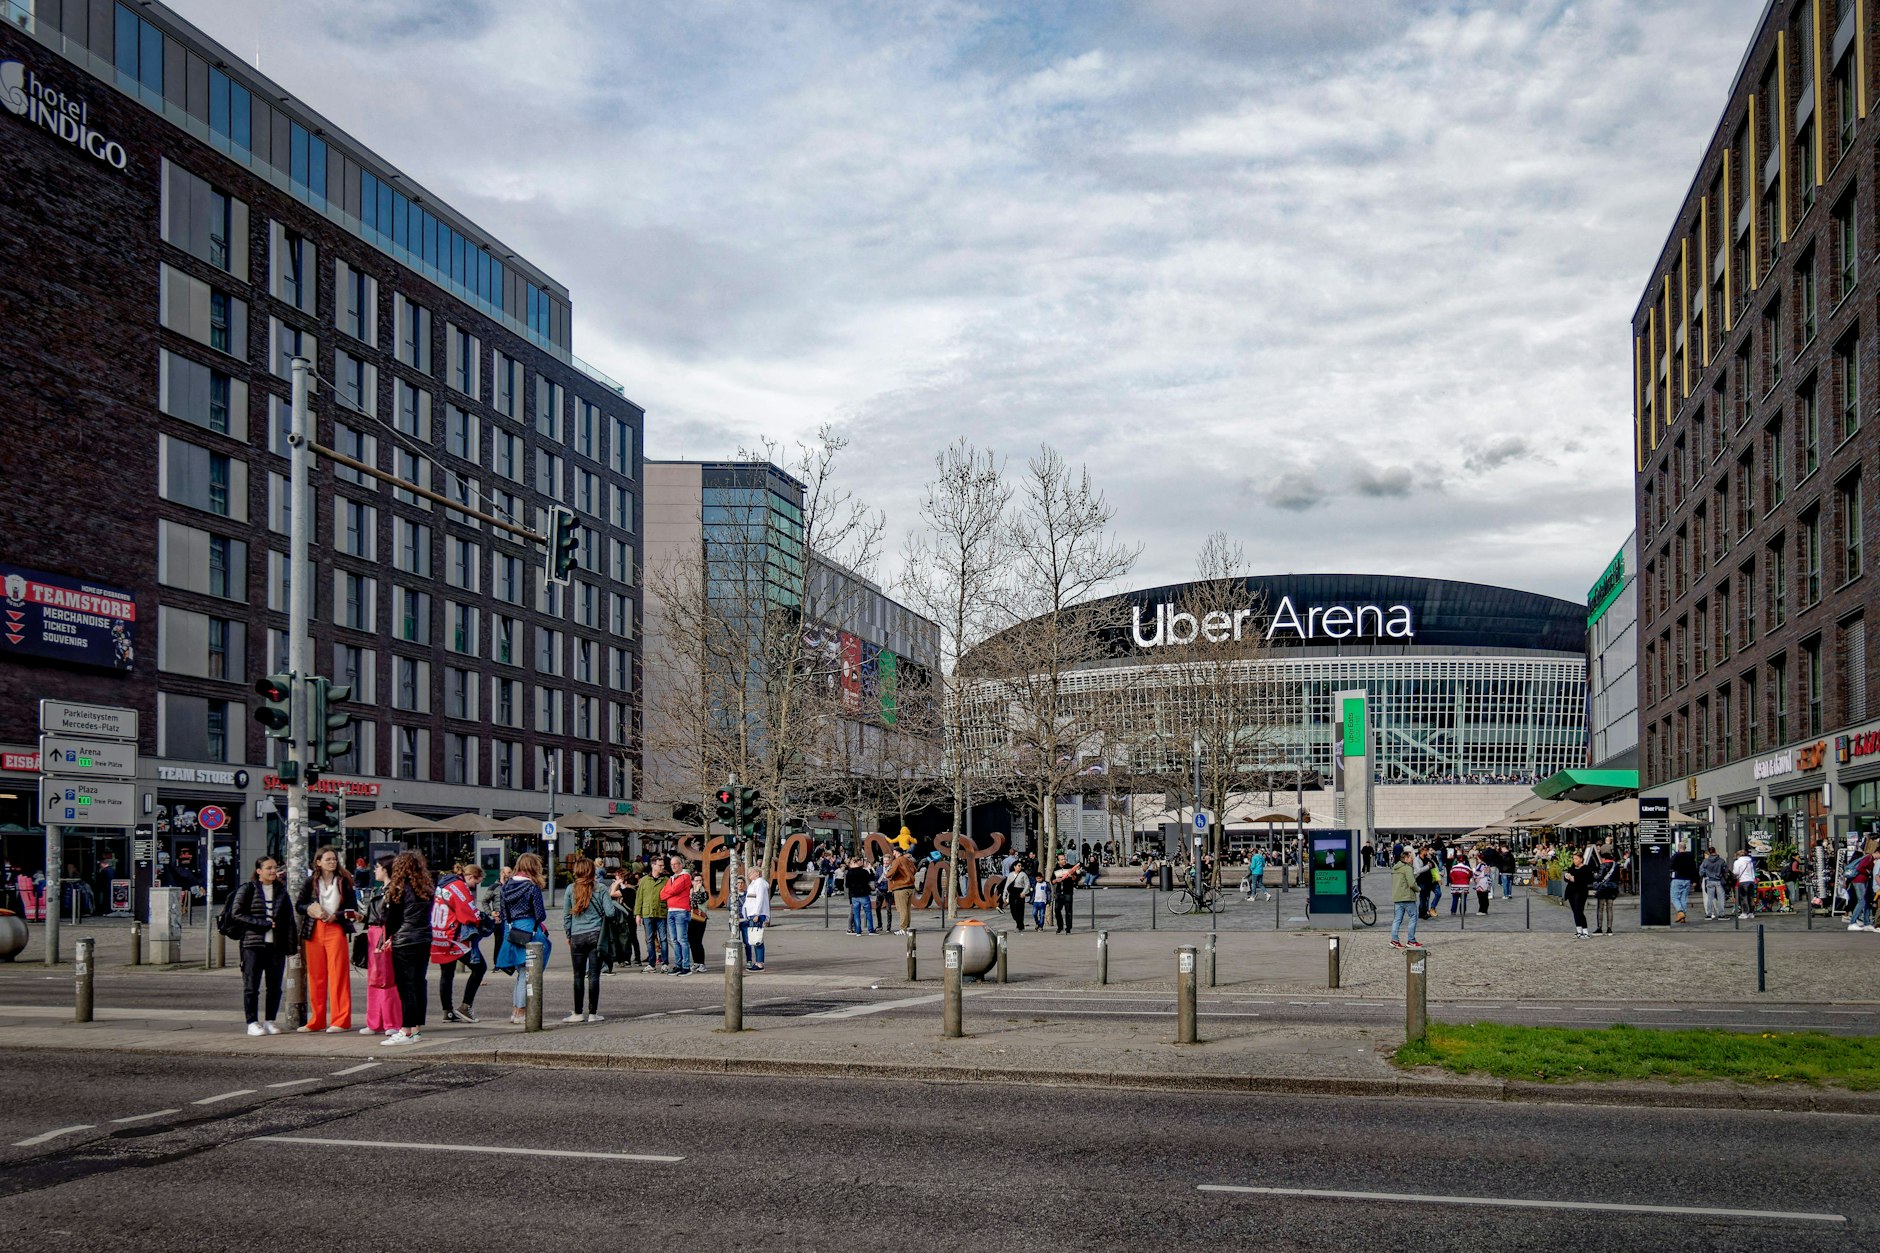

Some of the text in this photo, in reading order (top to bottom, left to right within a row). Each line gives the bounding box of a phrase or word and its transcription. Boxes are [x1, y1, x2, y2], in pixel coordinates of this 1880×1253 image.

[30, 71, 87, 125] hotel
[30, 95, 127, 169] INDIGO
[33, 585, 131, 619] TEAMSTORE
[43, 607, 110, 629] MERCHANDISE
[1132, 596, 1415, 648] Uber Arena
[43, 620, 77, 634] TICKETS
[43, 632, 88, 648] SOUVENIRS
[64, 709, 119, 722] Parkleitsystem
[62, 719, 120, 732] Mercedes-Platz
[79, 747, 102, 757] Arena
[159, 766, 235, 785] TEAM STORE
[78, 785, 98, 794] Plaza
